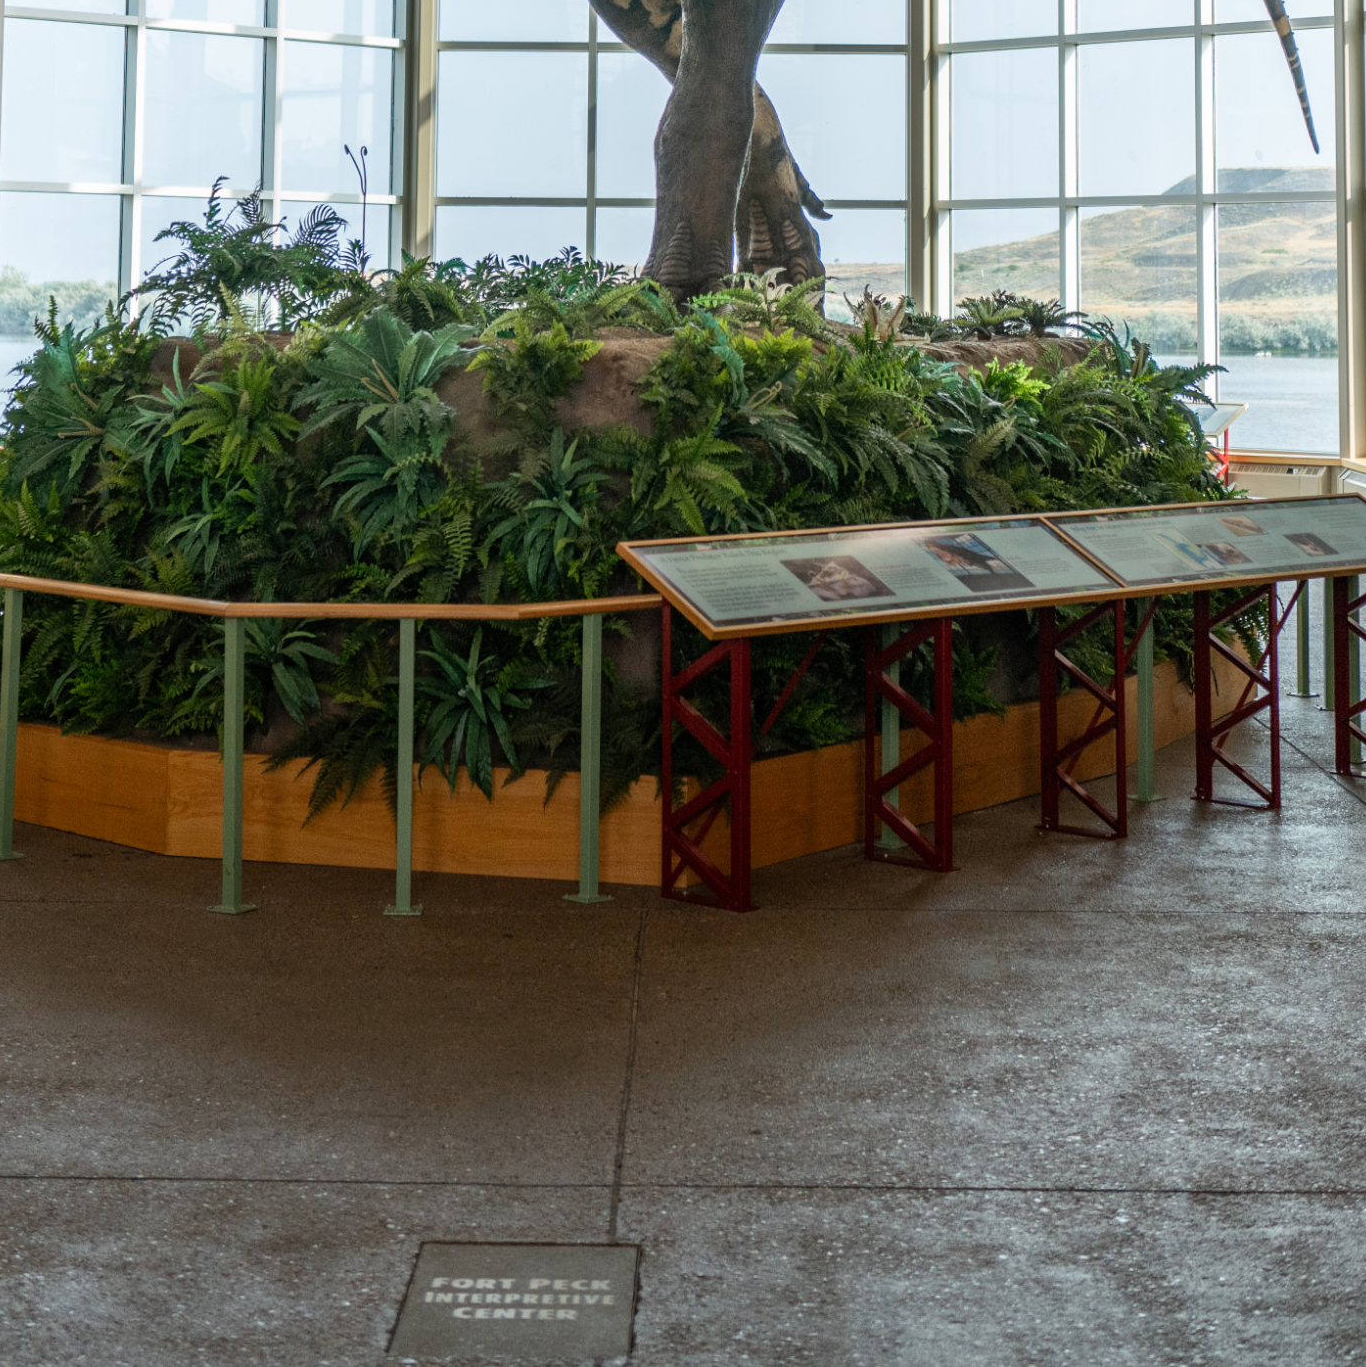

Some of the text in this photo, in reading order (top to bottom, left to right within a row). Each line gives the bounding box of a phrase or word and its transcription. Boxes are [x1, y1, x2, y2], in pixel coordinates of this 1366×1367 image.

[431, 1276, 611, 1291] FORT PECK
[424, 1291, 616, 1306] INTERPRETIVE
[452, 1307, 578, 1321] CENTER
